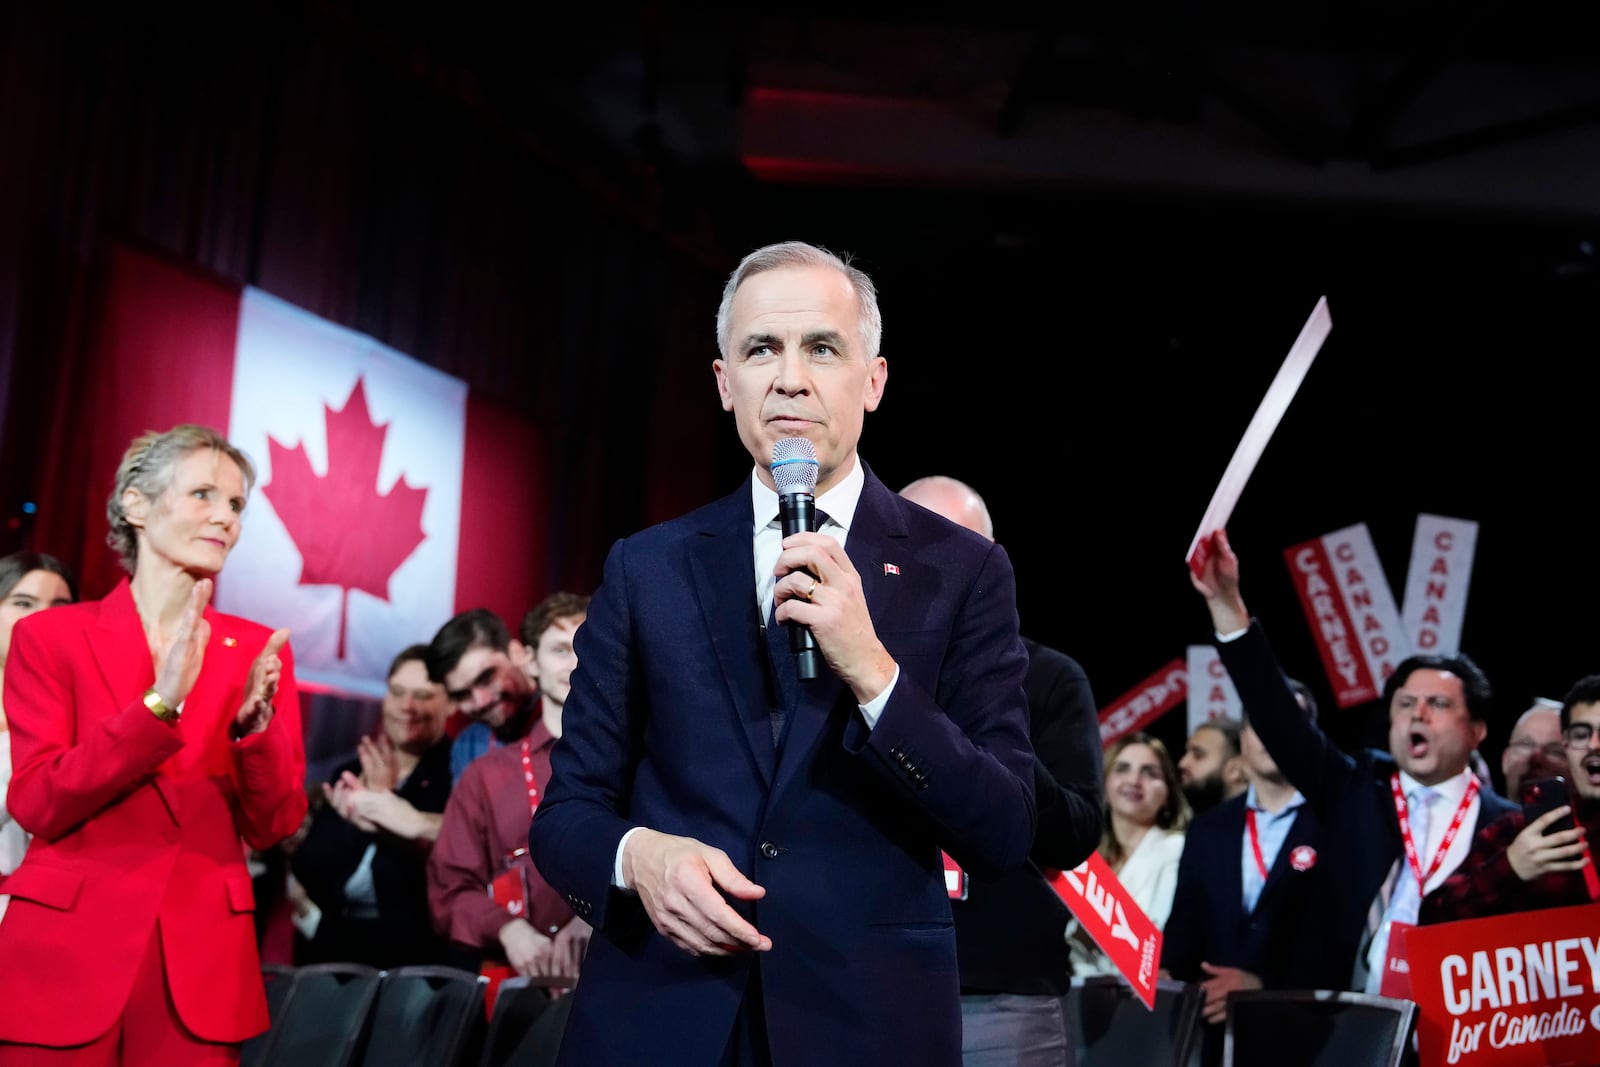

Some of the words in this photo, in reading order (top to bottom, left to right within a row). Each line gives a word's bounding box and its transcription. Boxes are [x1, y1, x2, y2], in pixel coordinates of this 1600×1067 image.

[1295, 548, 1359, 687] CARNEY
[1418, 531, 1454, 650] CANAD
[1207, 658, 1227, 720] CA
[1440, 936, 1600, 1015] CARNEY
[1446, 1018, 1487, 1065] for
[1489, 1001, 1586, 1049] Canada
